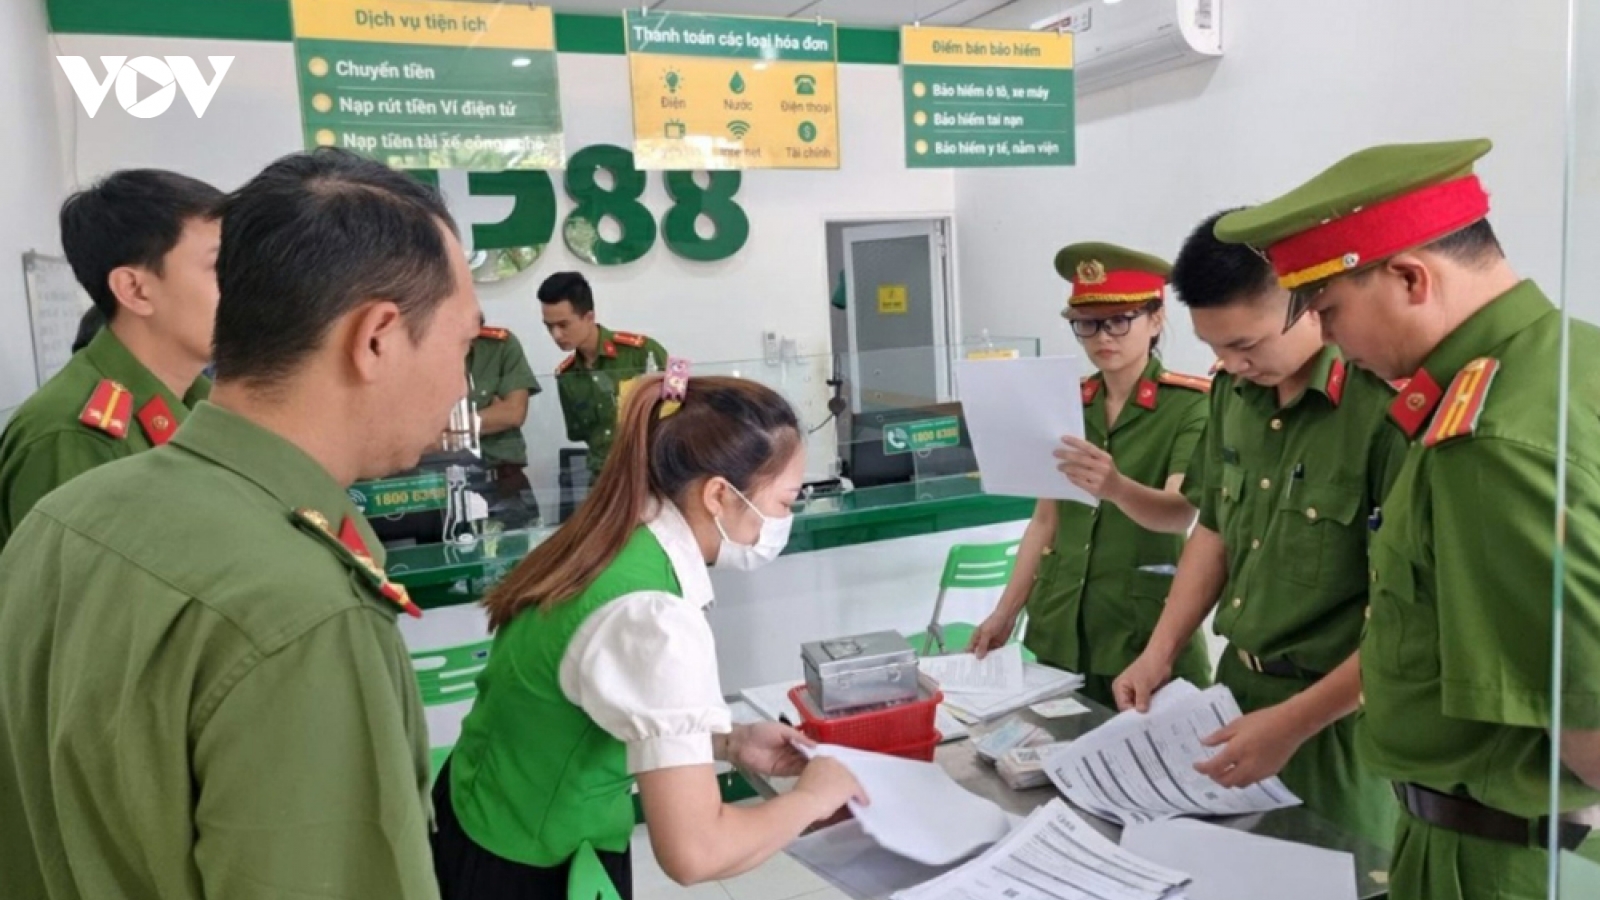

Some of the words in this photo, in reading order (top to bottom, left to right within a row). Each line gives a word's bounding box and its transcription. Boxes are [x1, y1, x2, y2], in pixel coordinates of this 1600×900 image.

[400, 17, 421, 32] vụ
[633, 26, 680, 44] Thanh
[683, 29, 716, 46] toán
[718, 32, 744, 48] các
[746, 32, 773, 51] loại
[774, 33, 800, 50] hóa
[802, 36, 829, 52] đơn
[1012, 88, 1025, 99] xe
[339, 97, 374, 117] Nạp
[343, 131, 377, 152] Nạp
